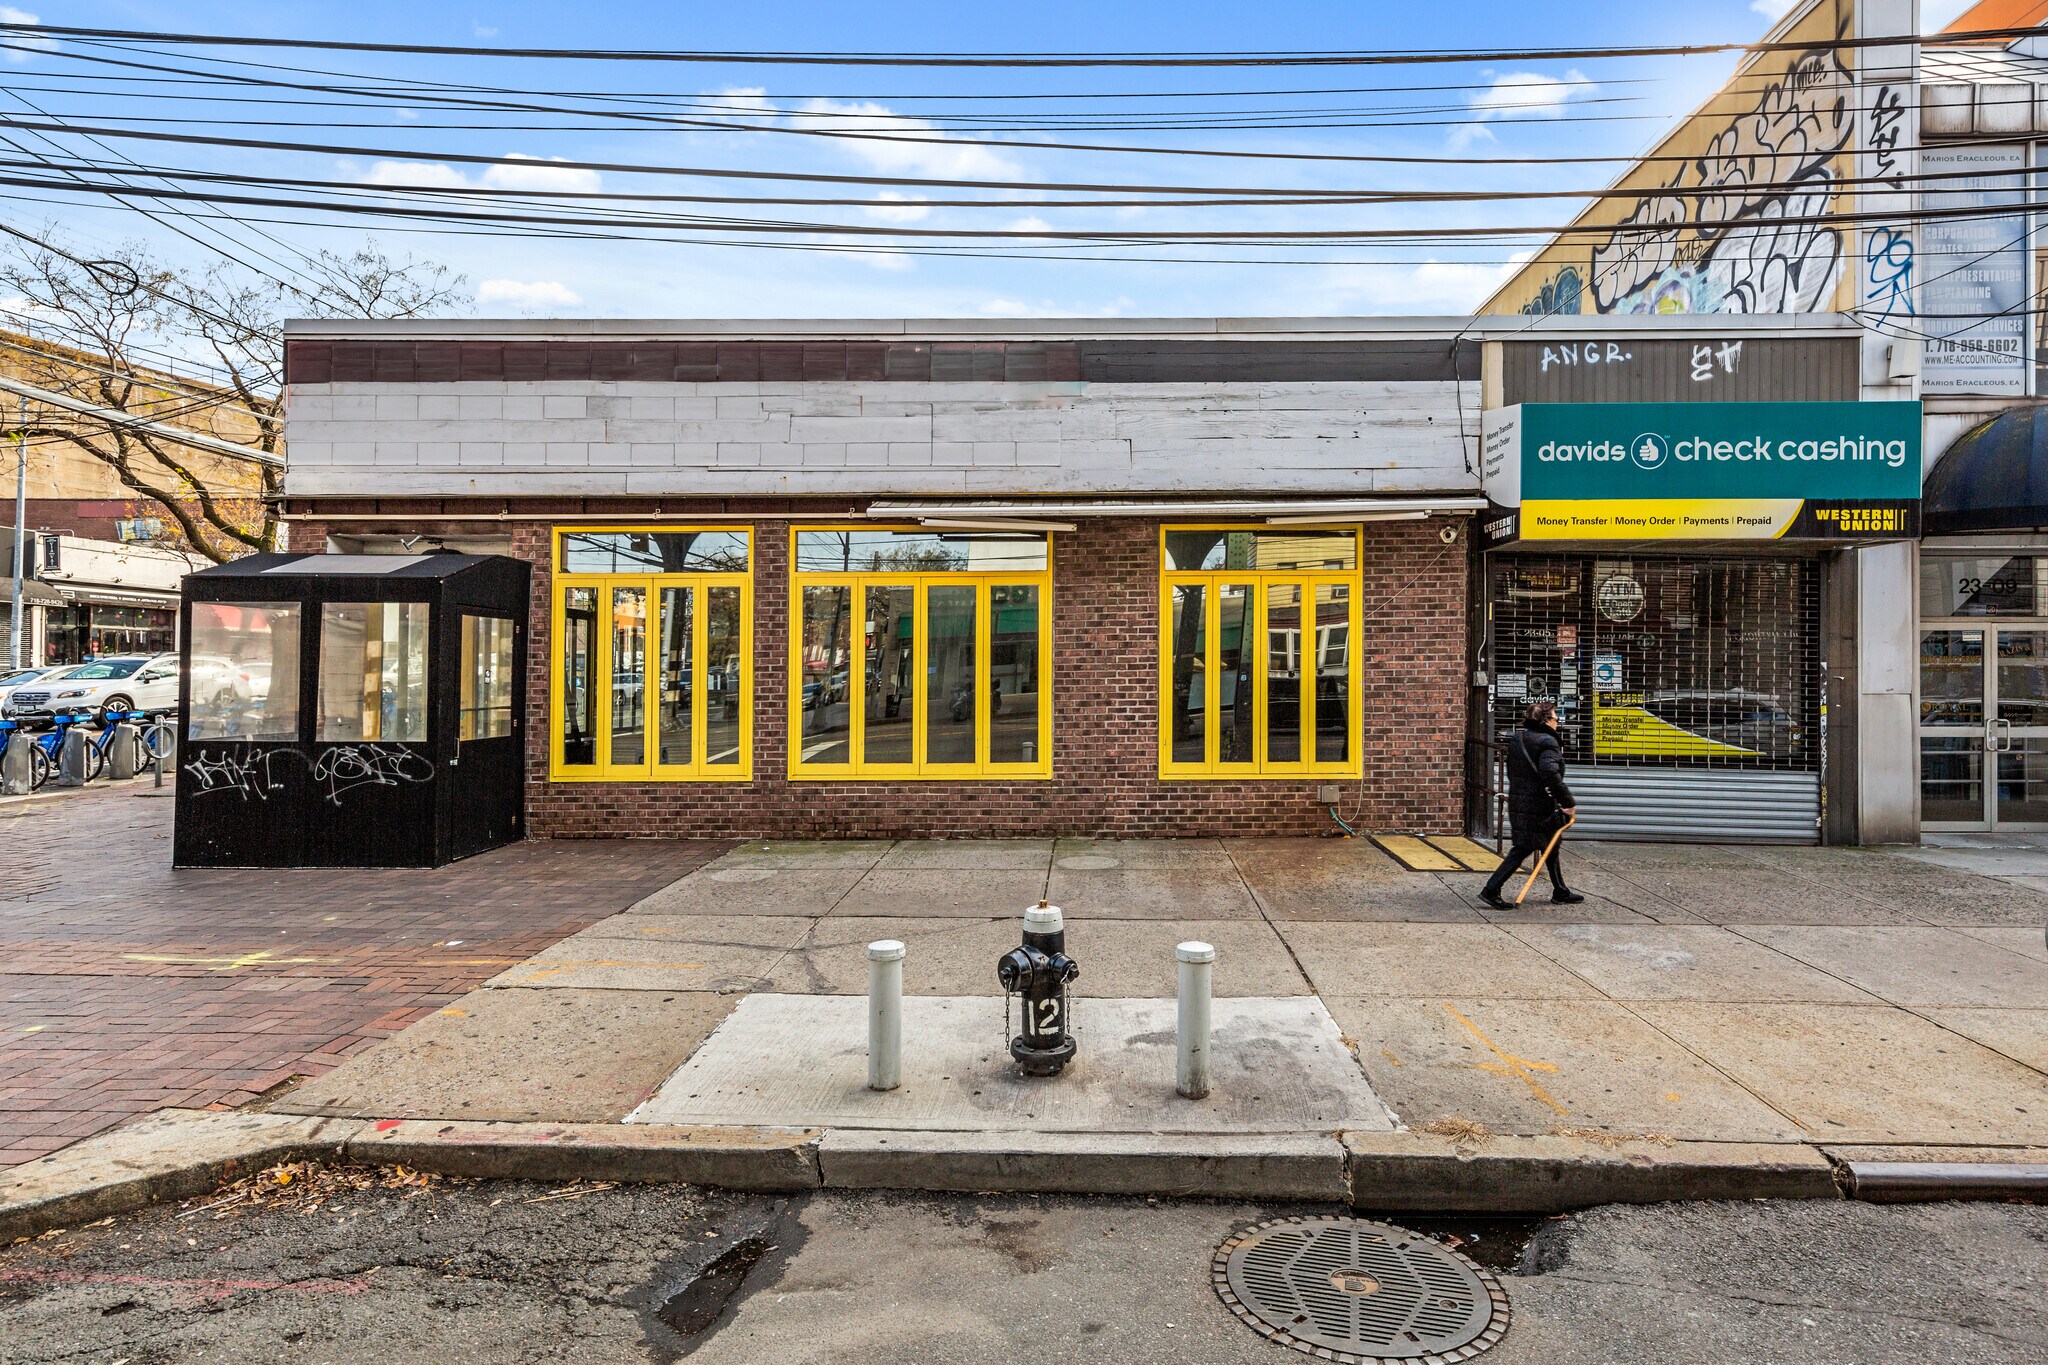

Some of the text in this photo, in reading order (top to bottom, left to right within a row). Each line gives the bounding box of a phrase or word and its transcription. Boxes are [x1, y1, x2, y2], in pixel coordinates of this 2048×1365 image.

[1984, 319, 2023, 332] SERVICES
[1924, 340, 2018, 352] T. 718-956-6602
[1538, 440, 1626, 462] davids
[1674, 435, 1906, 467] check cashing
[1816, 509, 1894, 520] WESTERN
[1483, 516, 1511, 534] WESTERN
[1536, 516, 1772, 527] Money Transfer Money Order Payments Prepaid
[1840, 520, 1894, 531] UNION
[1491, 526, 1511, 540] UNION
[1605, 583, 1636, 595] ATM
[1958, 577, 2017, 594] 23-09
[1519, 694, 1556, 704] davids
[1028, 998, 1060, 1036] 12
